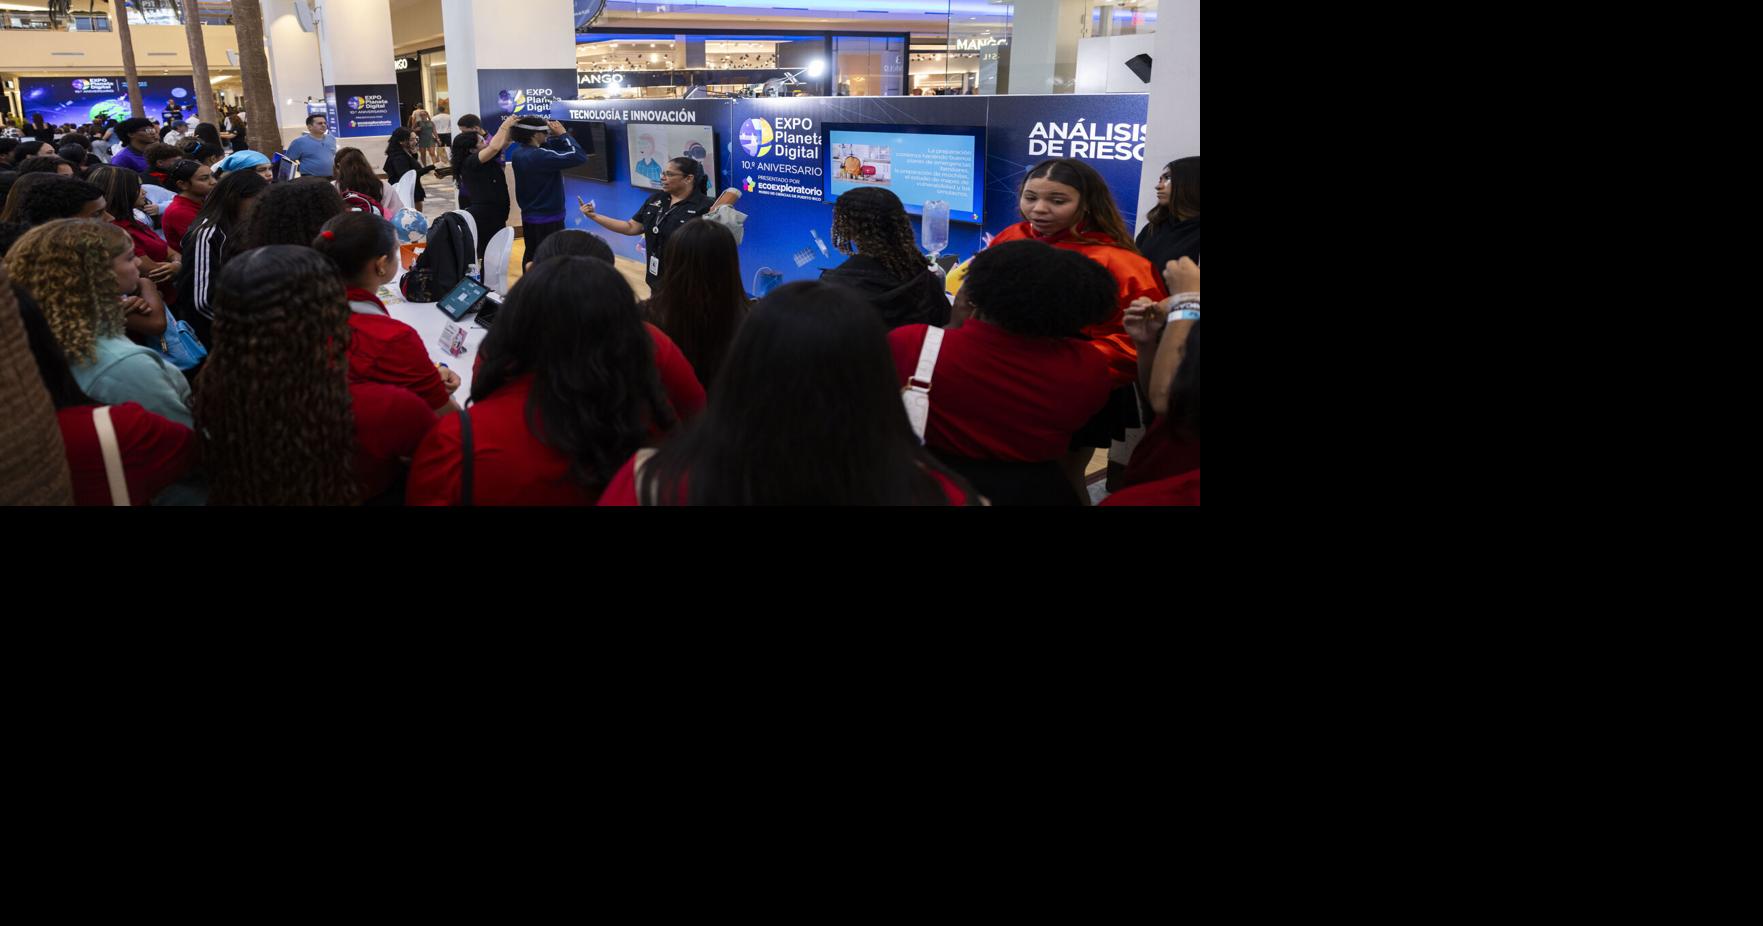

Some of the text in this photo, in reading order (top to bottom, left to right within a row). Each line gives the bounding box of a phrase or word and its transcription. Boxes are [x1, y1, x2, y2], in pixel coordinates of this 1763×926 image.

[578, 74, 623, 84] ANGO
[526, 88, 552, 96] EXPO
[527, 104, 551, 112] Digit
[569, 108, 696, 122] TECNOLOGÍA E INNOVACIÓN
[775, 118, 812, 130] EXPO
[775, 144, 818, 160] Digital
[1029, 139, 1064, 157] DE
[757, 162, 823, 176] ANIVERSARIO
